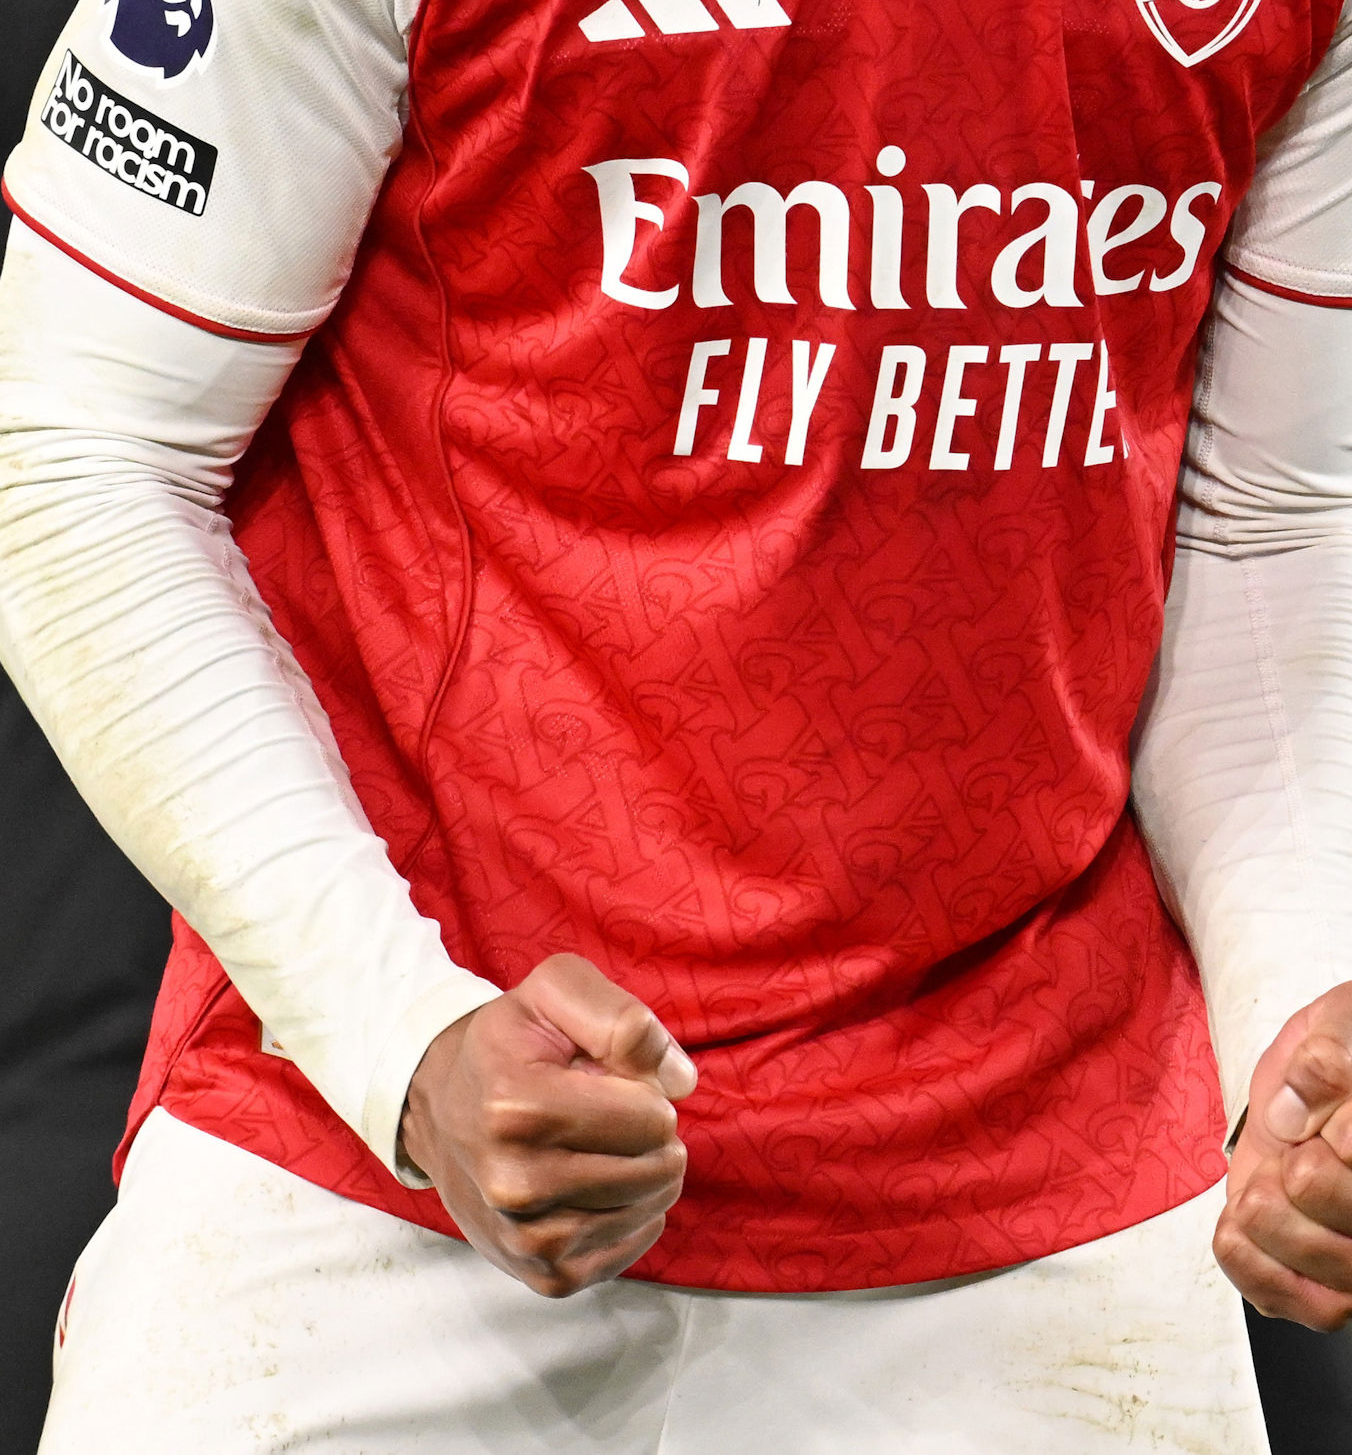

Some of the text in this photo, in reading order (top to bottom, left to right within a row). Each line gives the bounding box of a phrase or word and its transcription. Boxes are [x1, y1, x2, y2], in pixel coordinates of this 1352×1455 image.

[42, 86, 207, 215] for racism
[55, 52, 195, 174] No room
[581, 145, 1223, 311] Emiraes
[673, 337, 1131, 472] FLY BETTE
